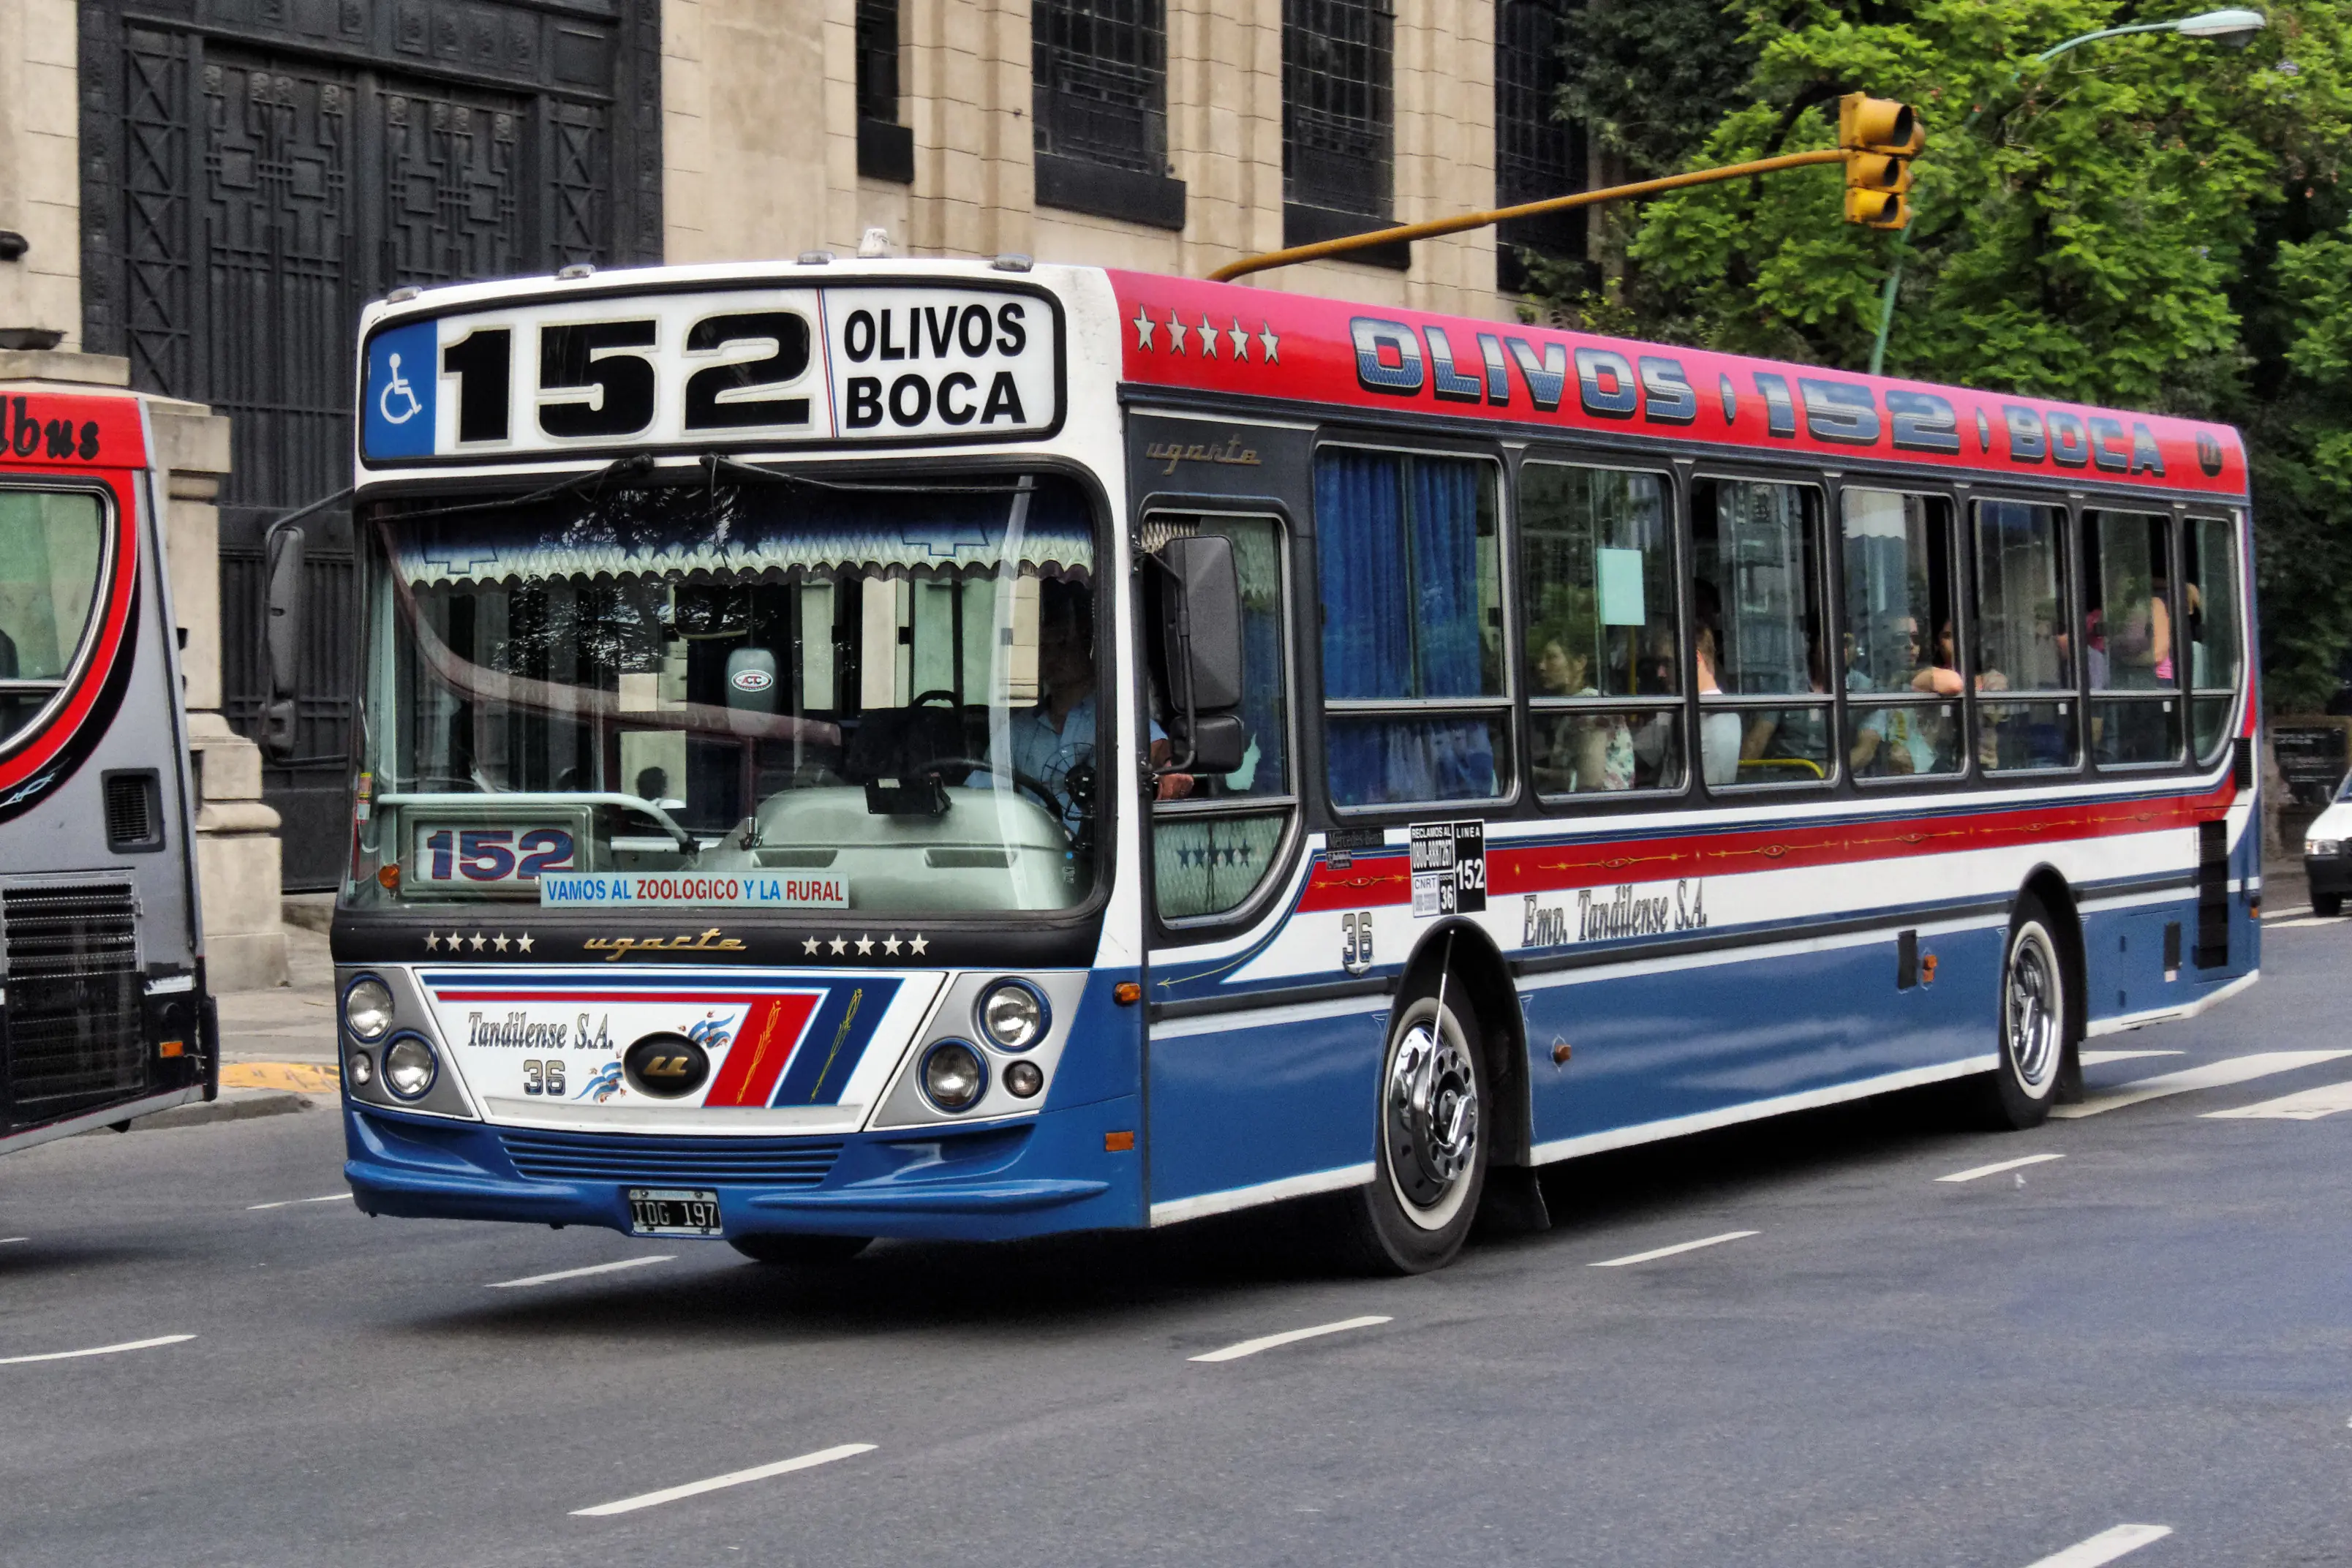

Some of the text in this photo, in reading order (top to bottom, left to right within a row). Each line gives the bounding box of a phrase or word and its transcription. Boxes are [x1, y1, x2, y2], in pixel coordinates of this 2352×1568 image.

[843, 302, 1026, 361] OLIVOS
[443, 307, 814, 448] 152
[845, 371, 1027, 429] BOCA
[1349, 316, 1696, 426] OLIVOS
[1752, 372, 1961, 457] 152
[2002, 404, 2166, 478] BOCA
[1146, 434, 1262, 475] ugarte
[1411, 826, 1452, 839] RECLAMOS AL
[1456, 826, 1481, 839] LINEA
[427, 829, 574, 881] 152
[1456, 858, 1485, 890] 152
[547, 879, 843, 901] VAMOS AL ZOOLOGICO Y LA RURAL
[1414, 877, 1436, 890] CNRT
[1440, 884, 1454, 910] 36
[1521, 878, 1708, 948] Emp. Tandilense S.A.
[583, 928, 747, 961] ugarte
[1342, 911, 1373, 965] 36
[468, 1011, 614, 1050] Tandilense S.A.
[523, 1059, 566, 1096] 36
[633, 1202, 715, 1226] IDG 197
